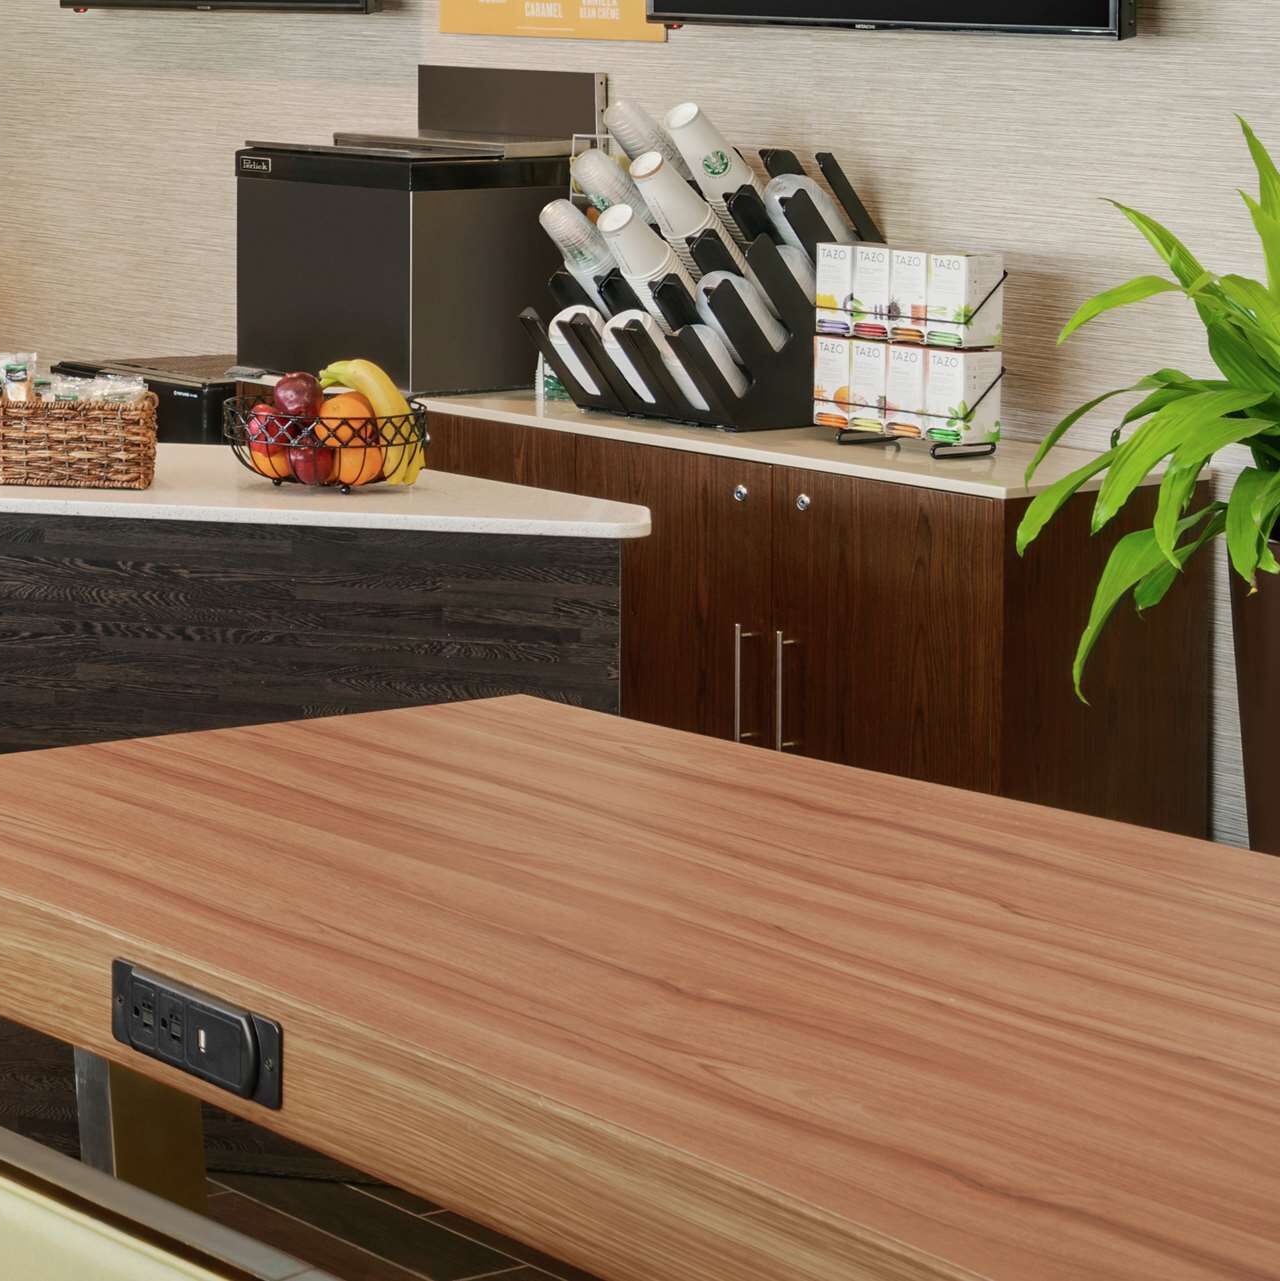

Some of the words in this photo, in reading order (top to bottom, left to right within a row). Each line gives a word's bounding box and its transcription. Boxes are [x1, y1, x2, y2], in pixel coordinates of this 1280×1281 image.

[524, 1, 563, 18] CARAMEL
[821, 249, 847, 260] TAZO
[859, 251, 885, 264] TAZO
[895, 254, 921, 267] TAZO
[934, 258, 960, 271] TAZO
[819, 341, 845, 354] TAZO
[855, 346, 881, 358] TAZO
[891, 350, 918, 363] TAZO
[932, 355, 959, 368] TAZO
